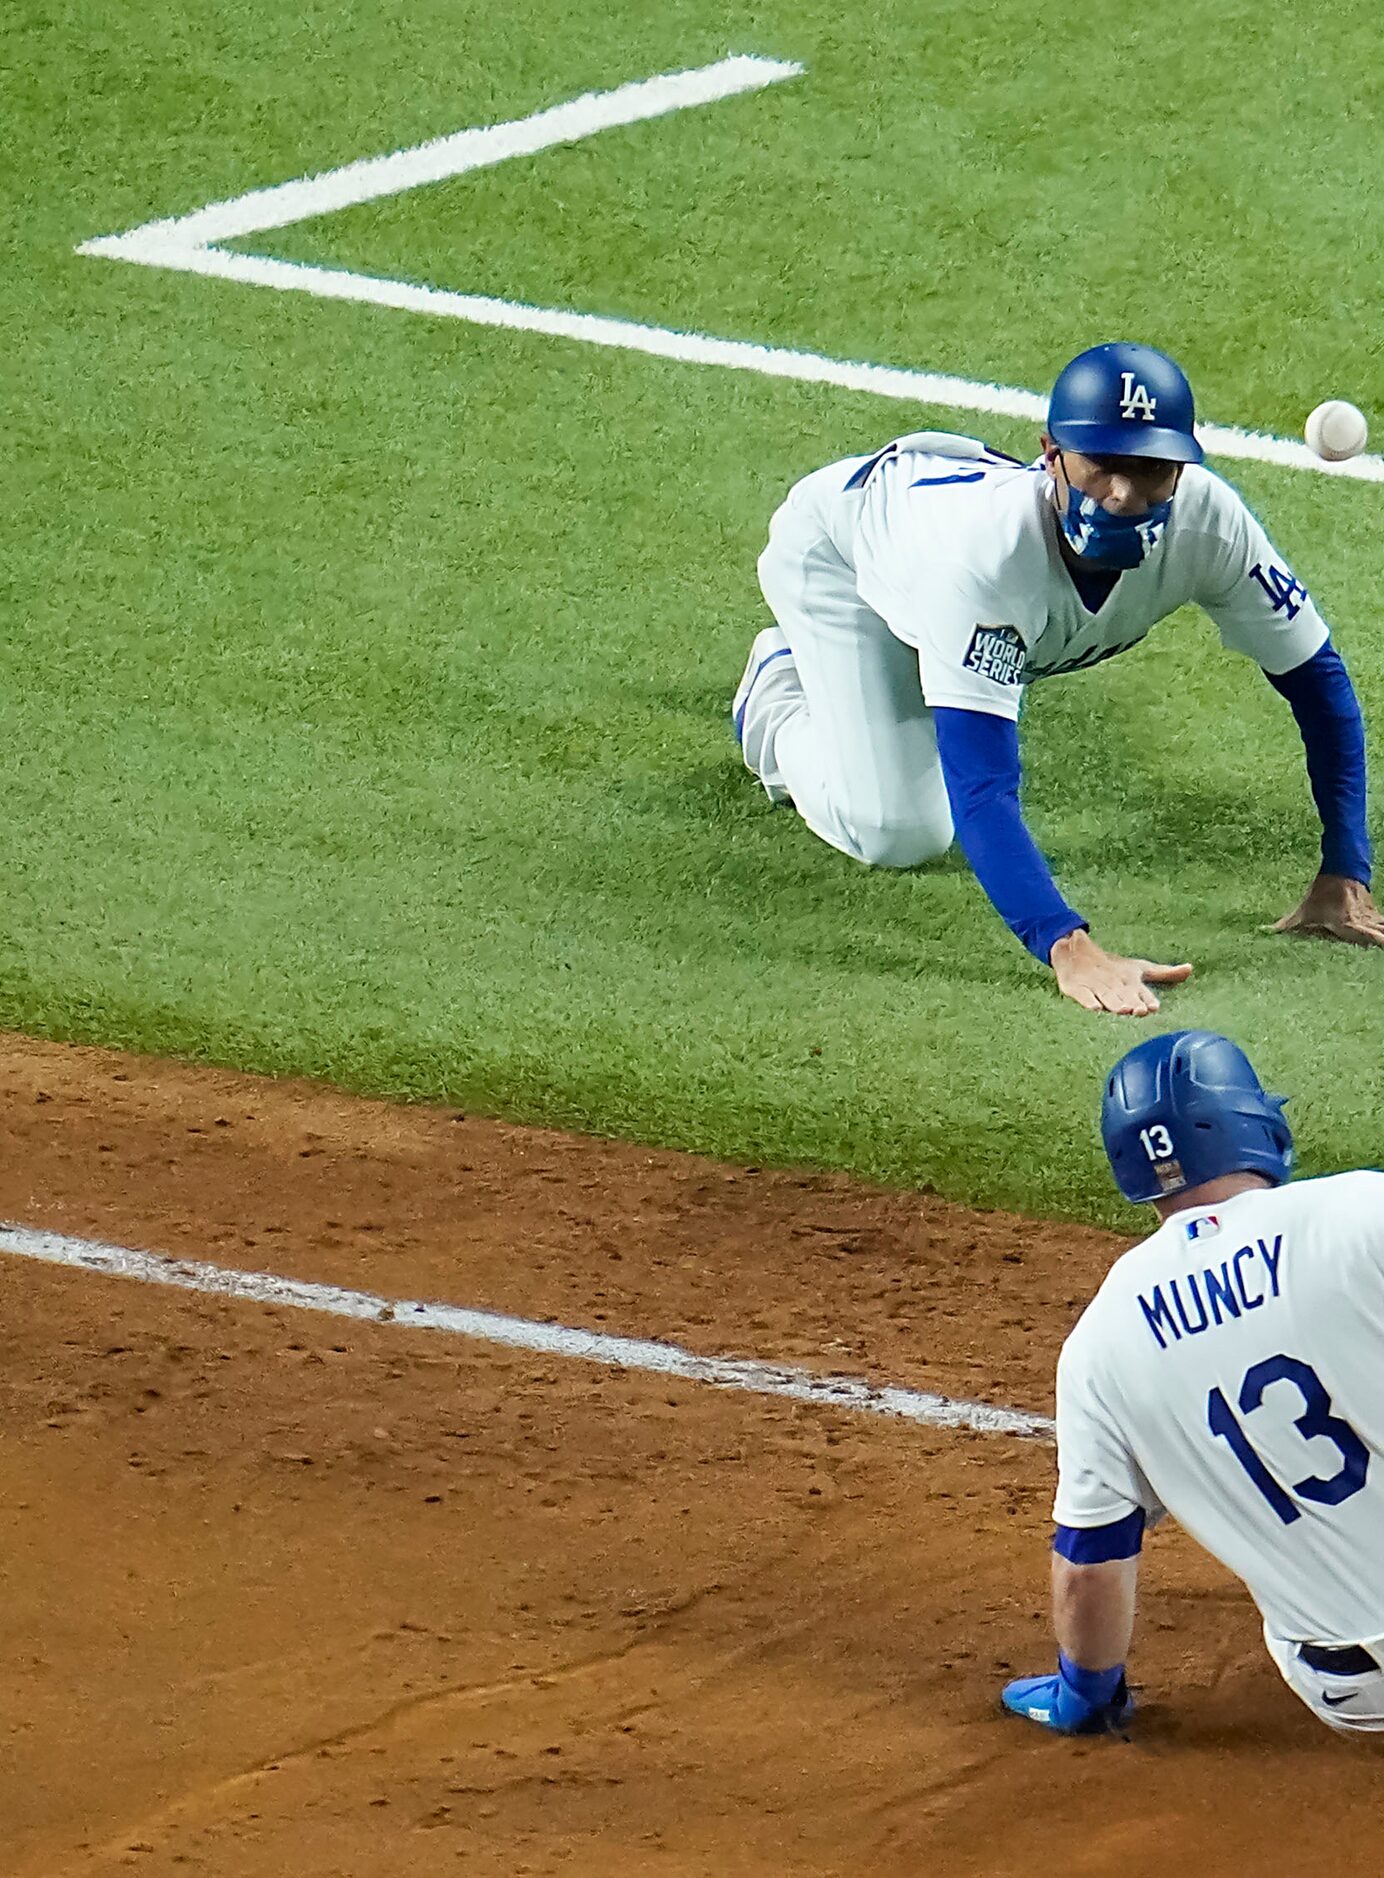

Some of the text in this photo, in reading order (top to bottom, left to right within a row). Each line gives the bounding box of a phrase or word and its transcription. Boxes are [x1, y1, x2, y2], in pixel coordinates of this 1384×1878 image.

[1120, 372, 1157, 421] LA
[1249, 562, 1308, 621] LA
[966, 652, 1021, 686] SERIES
[975, 631, 1026, 670] WORLD
[1139, 1124, 1174, 1161] 13
[1137, 1234, 1283, 1350] MUNCY
[1208, 1353, 1371, 1526] 13
